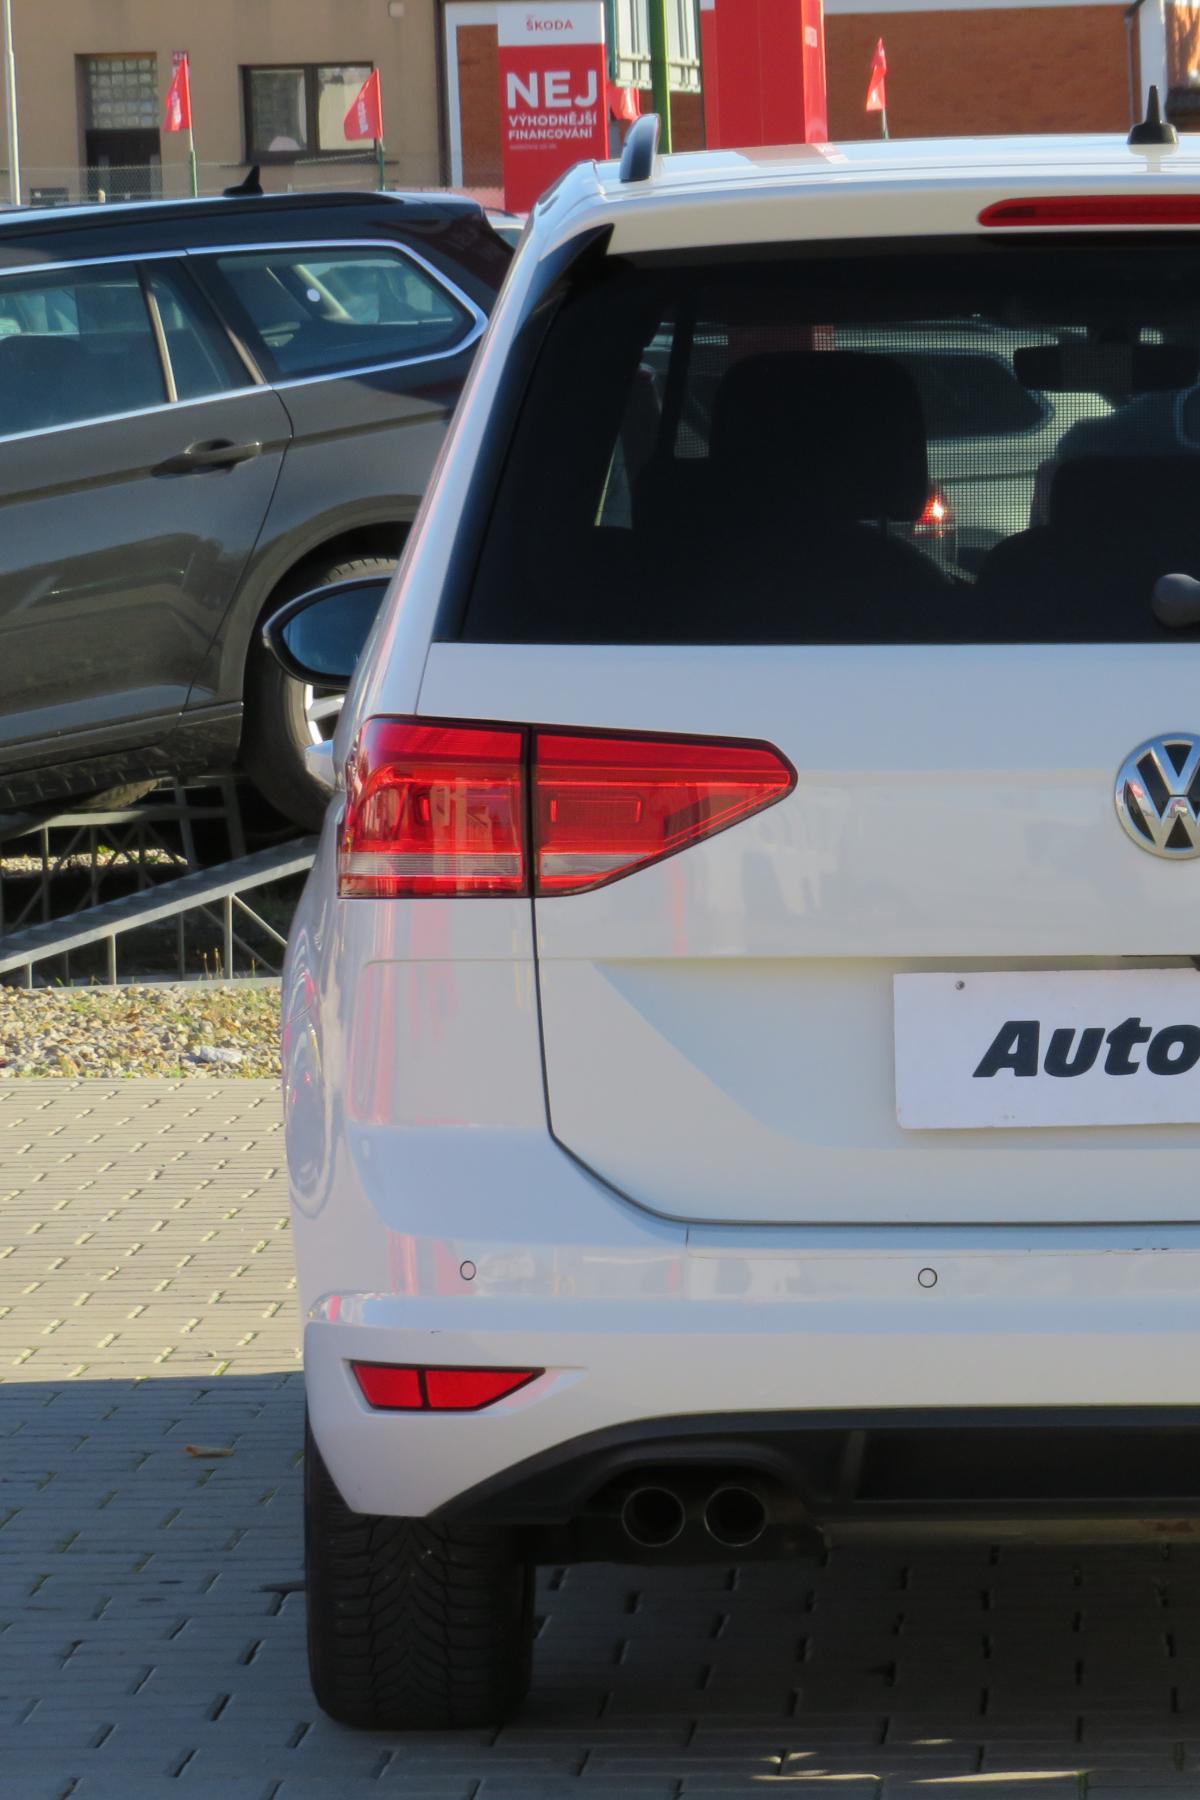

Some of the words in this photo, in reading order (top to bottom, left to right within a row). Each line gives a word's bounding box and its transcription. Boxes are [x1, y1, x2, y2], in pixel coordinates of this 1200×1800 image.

[526, 14, 574, 31] ŠKODA
[506, 69, 598, 109] NEJ
[508, 111, 597, 127] VÝHODNĚJŠÍ
[508, 127, 593, 140] FINANCOVÁNÍ
